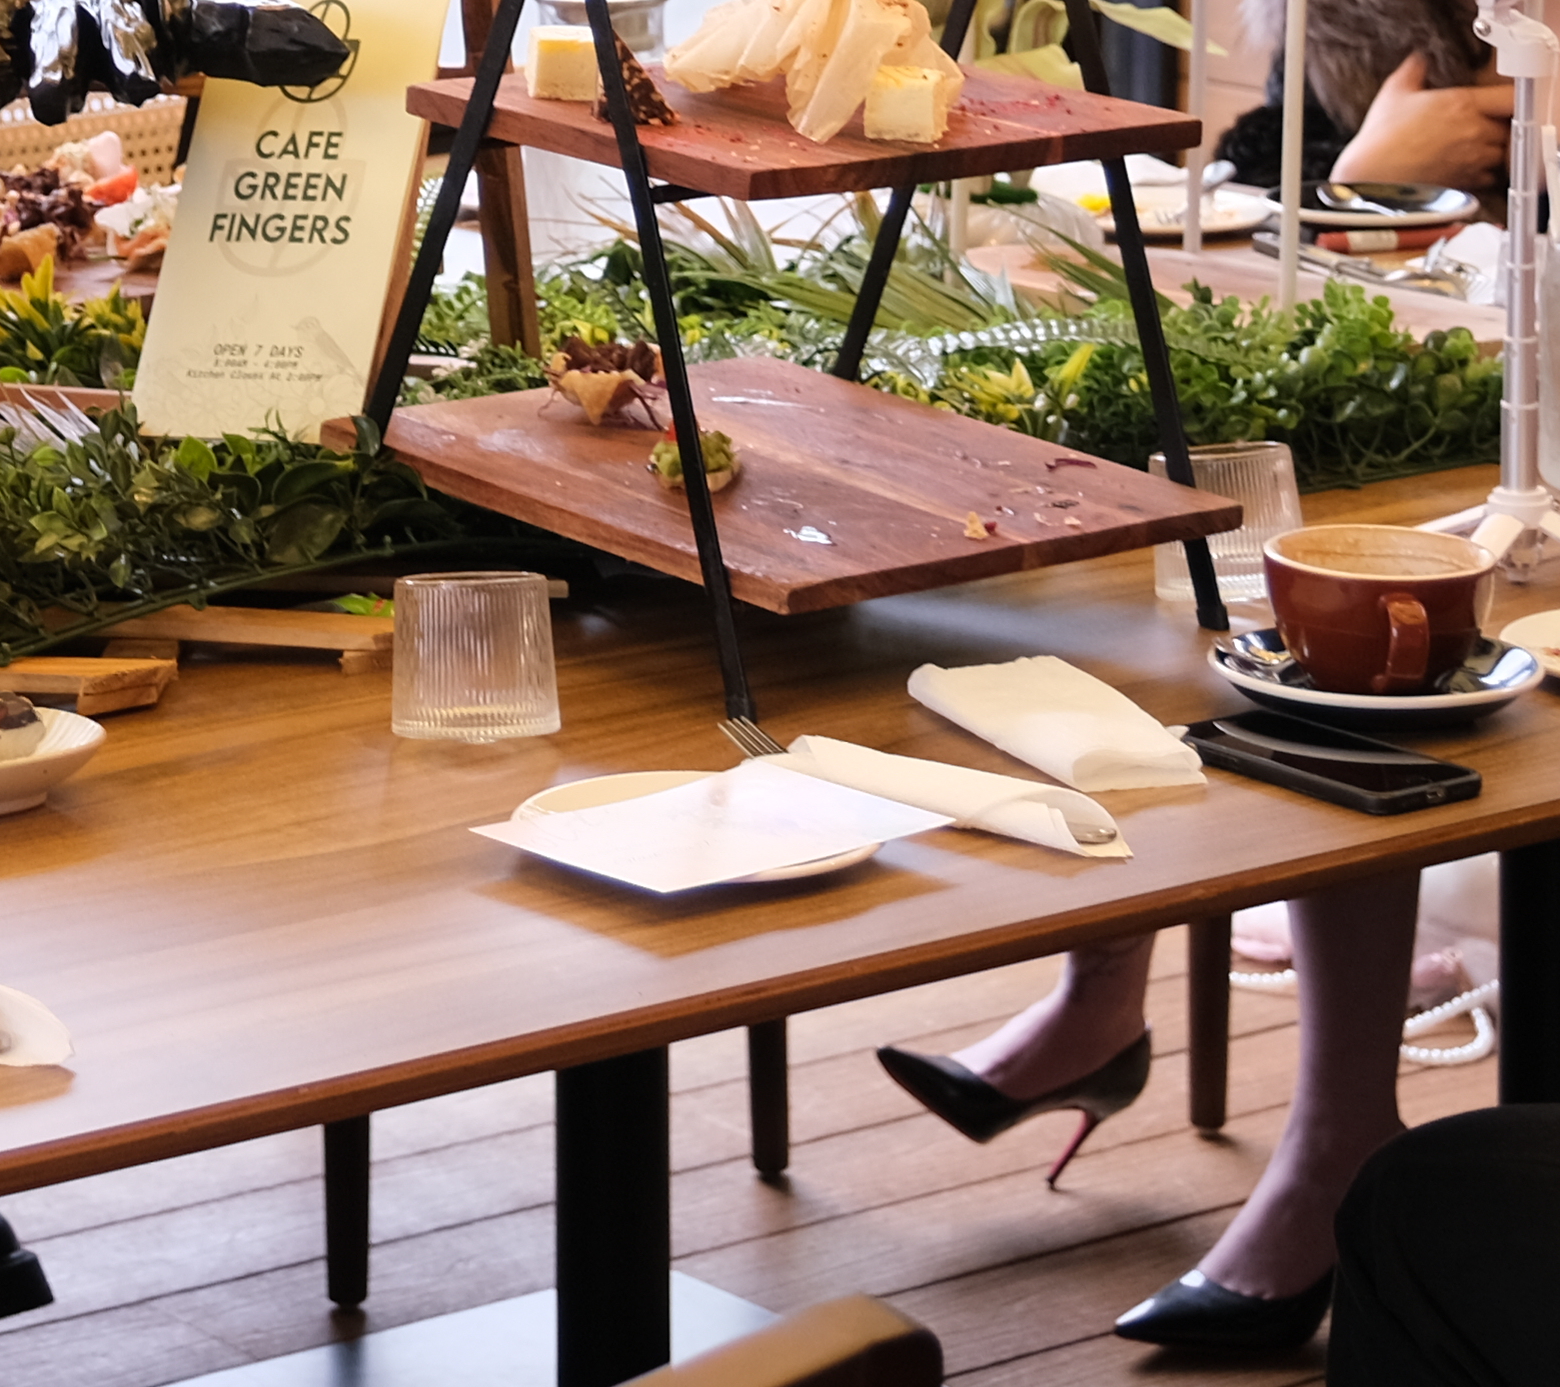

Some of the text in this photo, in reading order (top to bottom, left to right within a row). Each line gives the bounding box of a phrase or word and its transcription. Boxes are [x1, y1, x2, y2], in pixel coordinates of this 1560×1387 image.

[255, 129, 344, 160] CAFE
[234, 171, 348, 202] GREEN
[208, 213, 352, 246] FINGERS
[213, 343, 304, 359] OPEN 7 DAYS
